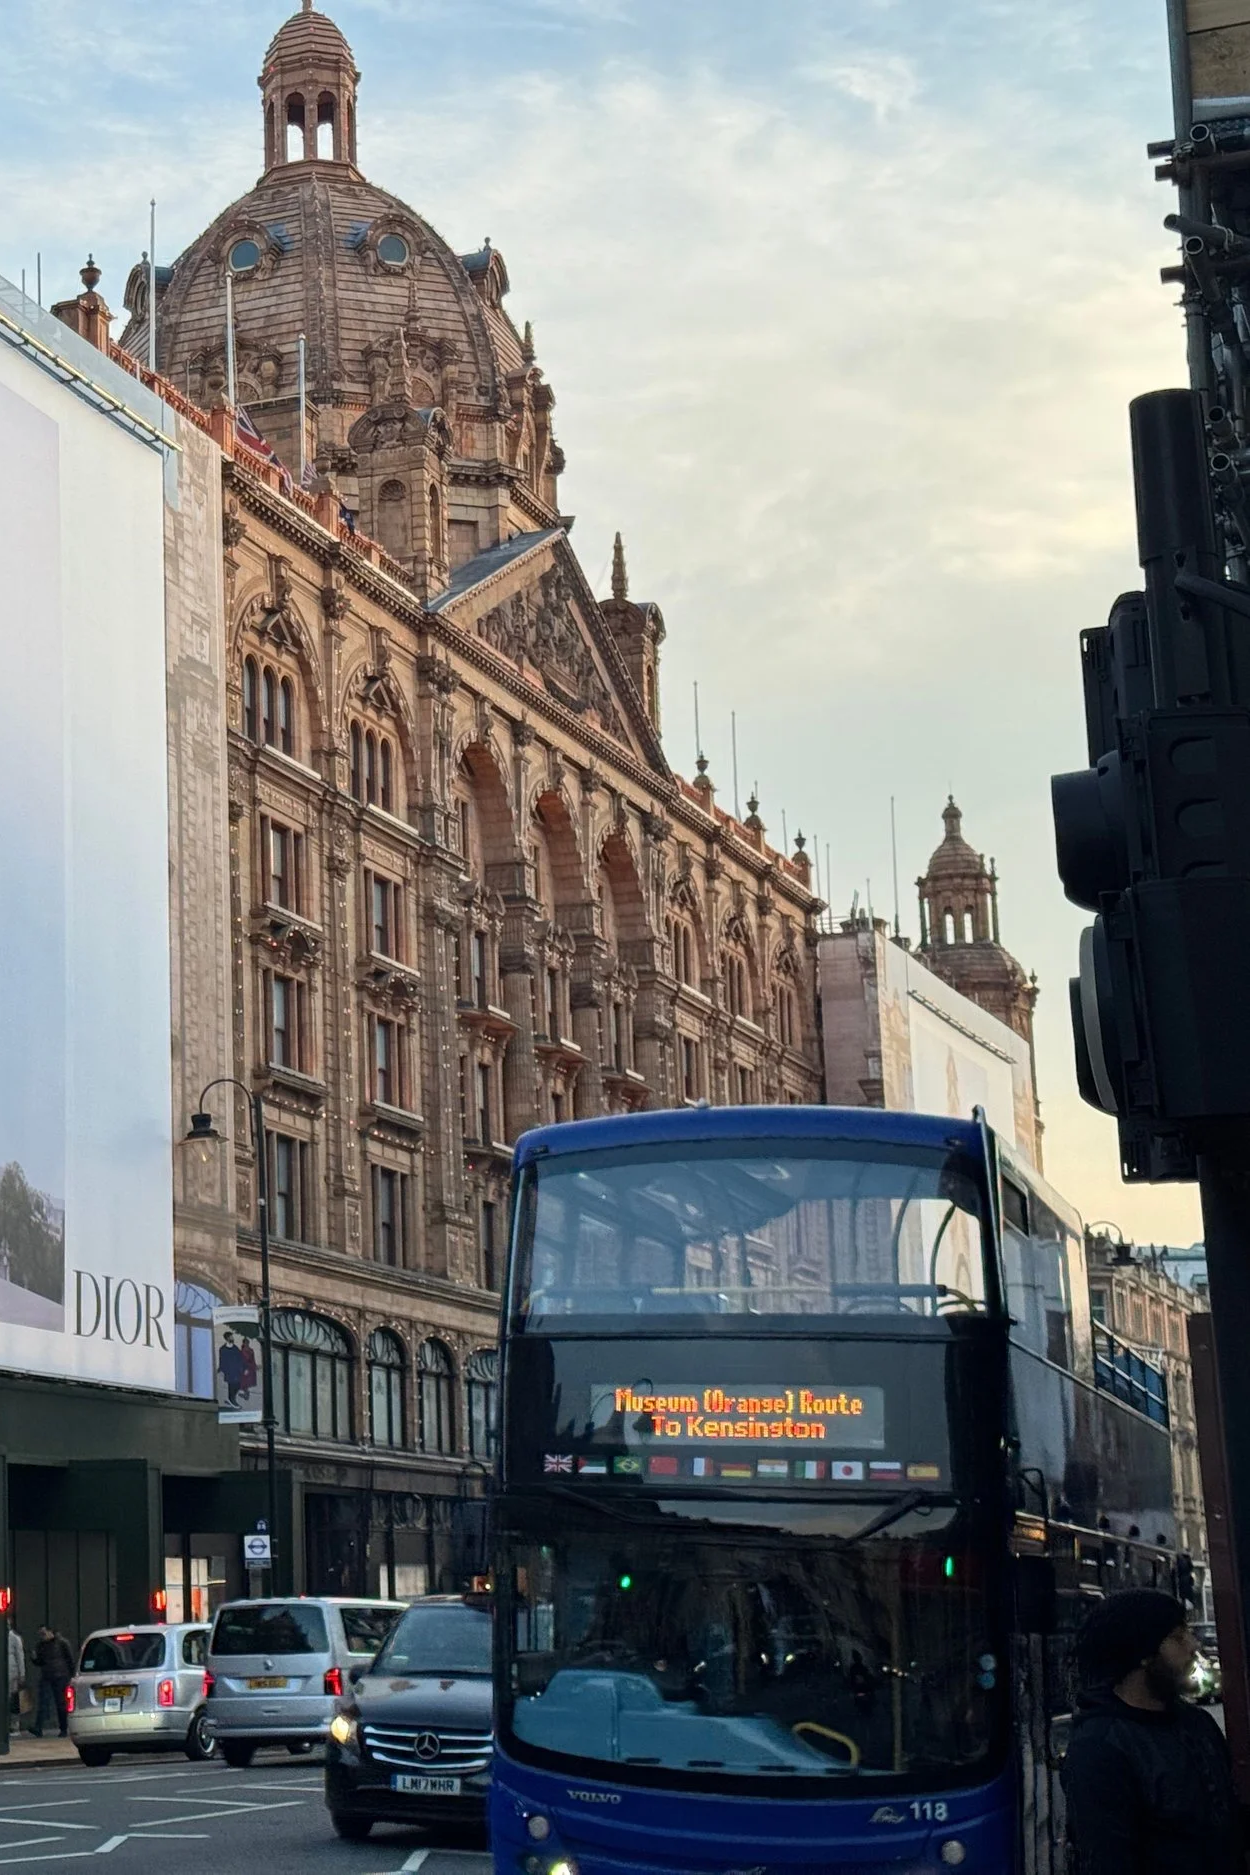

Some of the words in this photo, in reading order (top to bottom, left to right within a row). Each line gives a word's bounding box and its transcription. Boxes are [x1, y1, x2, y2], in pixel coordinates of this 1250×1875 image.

[72, 1269, 169, 1352] DIOR
[614, 1388, 698, 1413] Museum
[703, 1389, 793, 1415] (Orange)
[799, 1390, 863, 1415] Route
[651, 1415, 681, 1437] To
[687, 1416, 826, 1439] Kensington
[566, 1789, 622, 1804] VOLVO
[910, 1801, 949, 1822] 118
